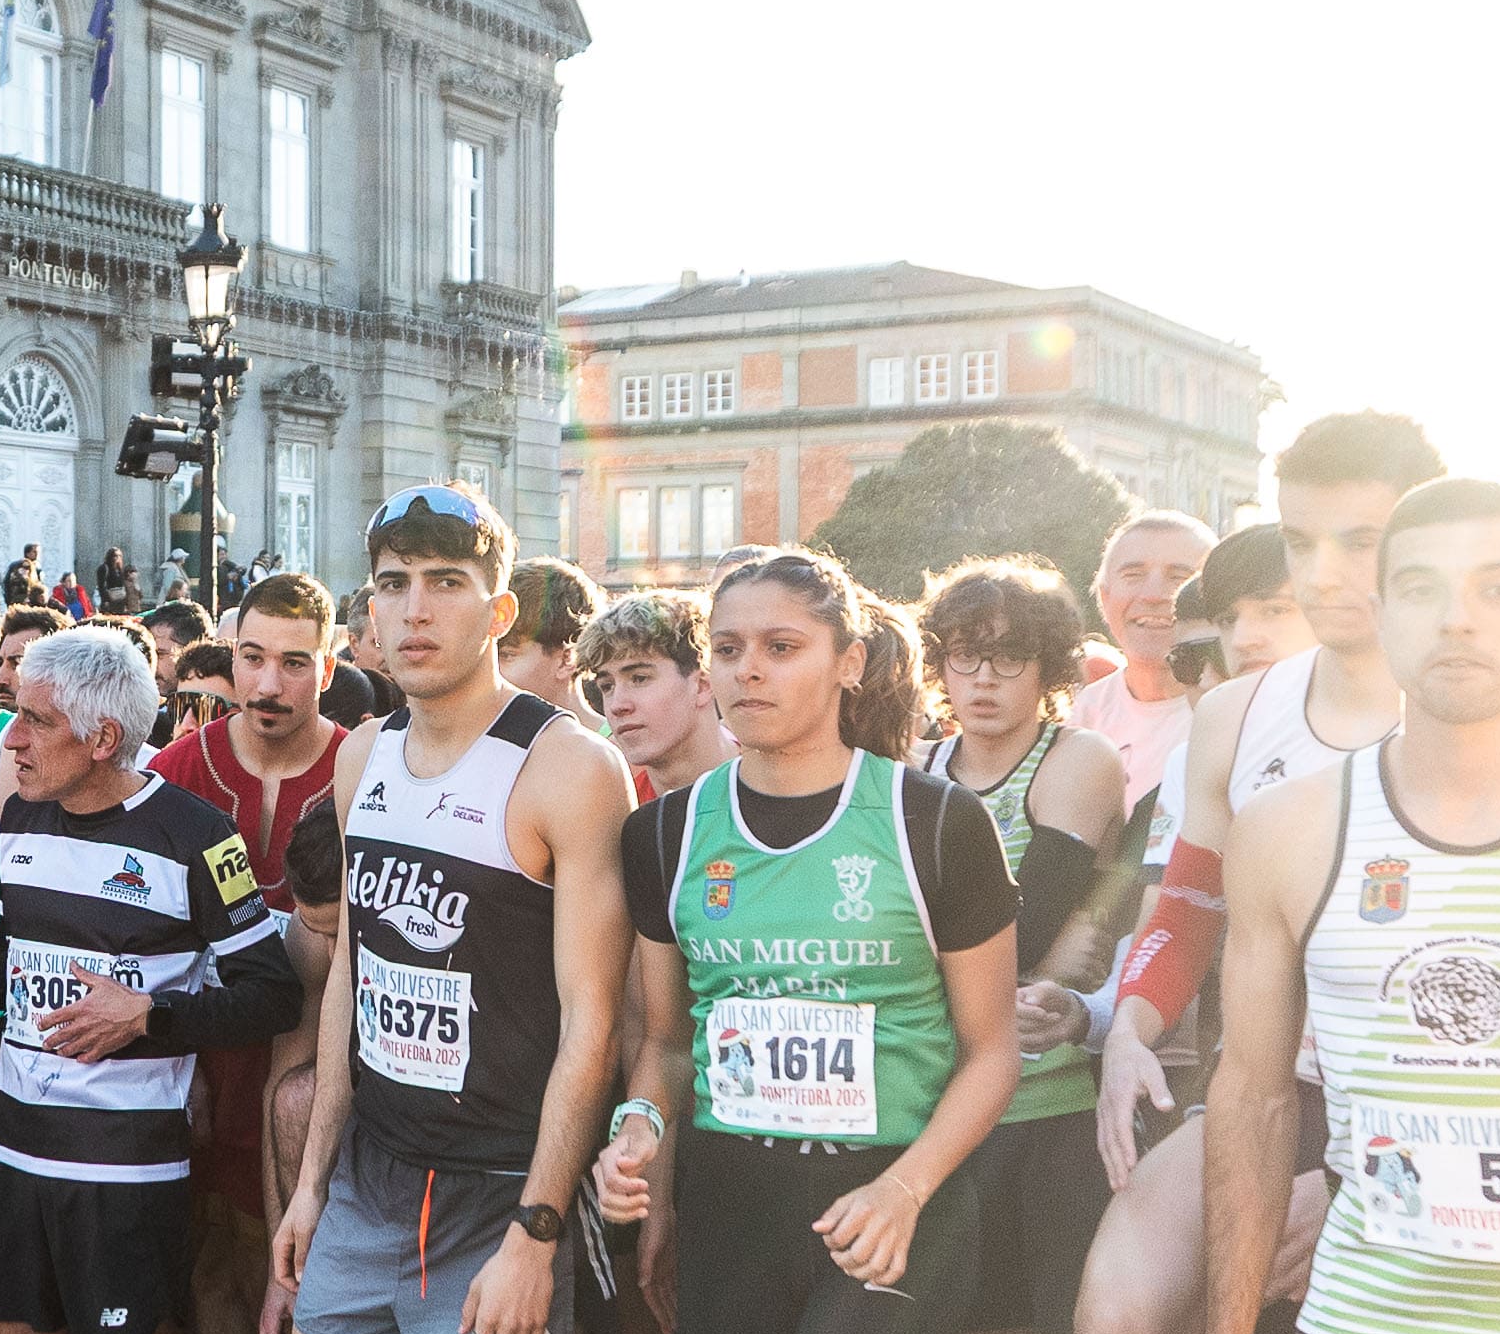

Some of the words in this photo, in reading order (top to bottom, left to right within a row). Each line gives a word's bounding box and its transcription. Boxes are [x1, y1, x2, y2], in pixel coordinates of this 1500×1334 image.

[347, 851, 470, 927] delikia
[405, 915, 439, 939] fresh
[21, 951, 42, 971] SAN
[689, 937, 743, 964] SAN
[752, 938, 901, 966] MIGUEL
[31, 975, 92, 1009] 305
[372, 961, 388, 990] SAN
[390, 969, 462, 1004] SILVESTRE
[379, 993, 460, 1044] 6375
[741, 1005, 772, 1031] SAN
[778, 1005, 864, 1034] SILVESTRE
[379, 1033, 432, 1064] PONTEVEDRA
[435, 1047, 461, 1067] 2025
[765, 1036, 856, 1083] 1614
[760, 1085, 832, 1107] PONTEVEDRA
[836, 1085, 866, 1107] 2025
[1397, 1111, 1441, 1145] SAN
